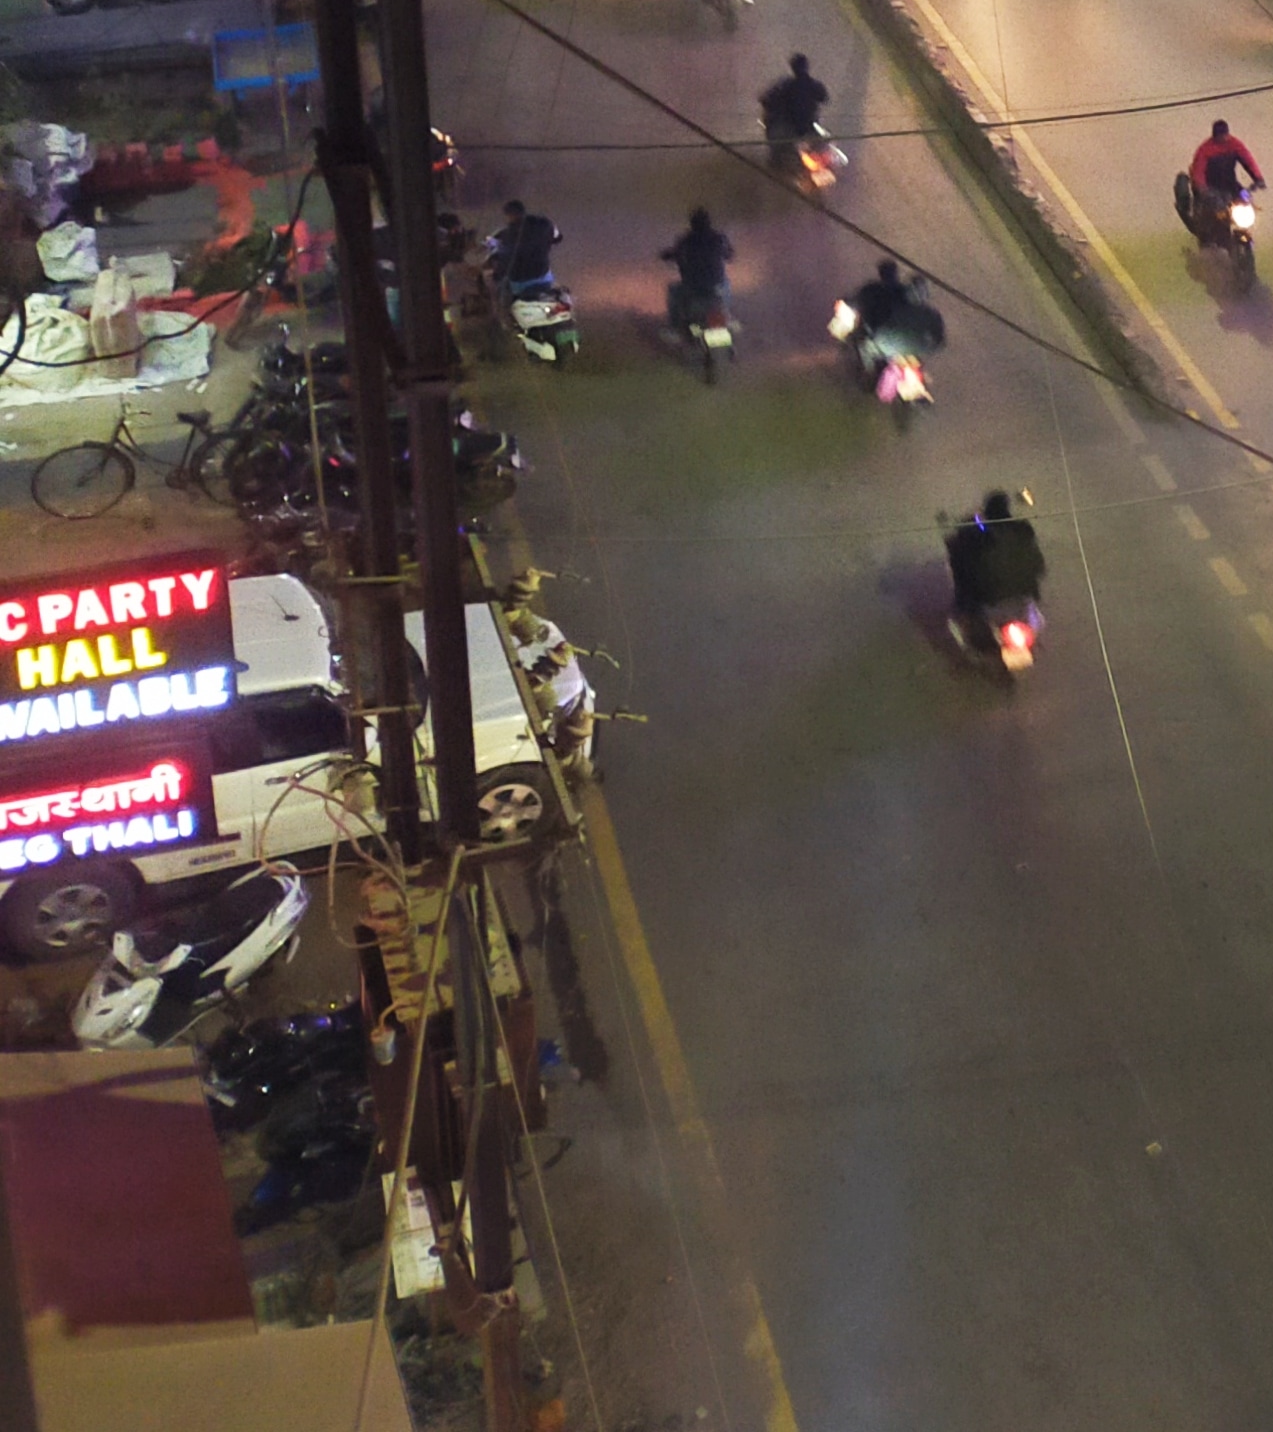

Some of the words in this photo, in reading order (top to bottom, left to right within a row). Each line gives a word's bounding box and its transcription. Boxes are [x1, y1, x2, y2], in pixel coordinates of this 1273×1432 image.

[38, 569, 215, 636] PARTY
[16, 626, 168, 691] HALL
[62, 809, 194, 856] THALI
